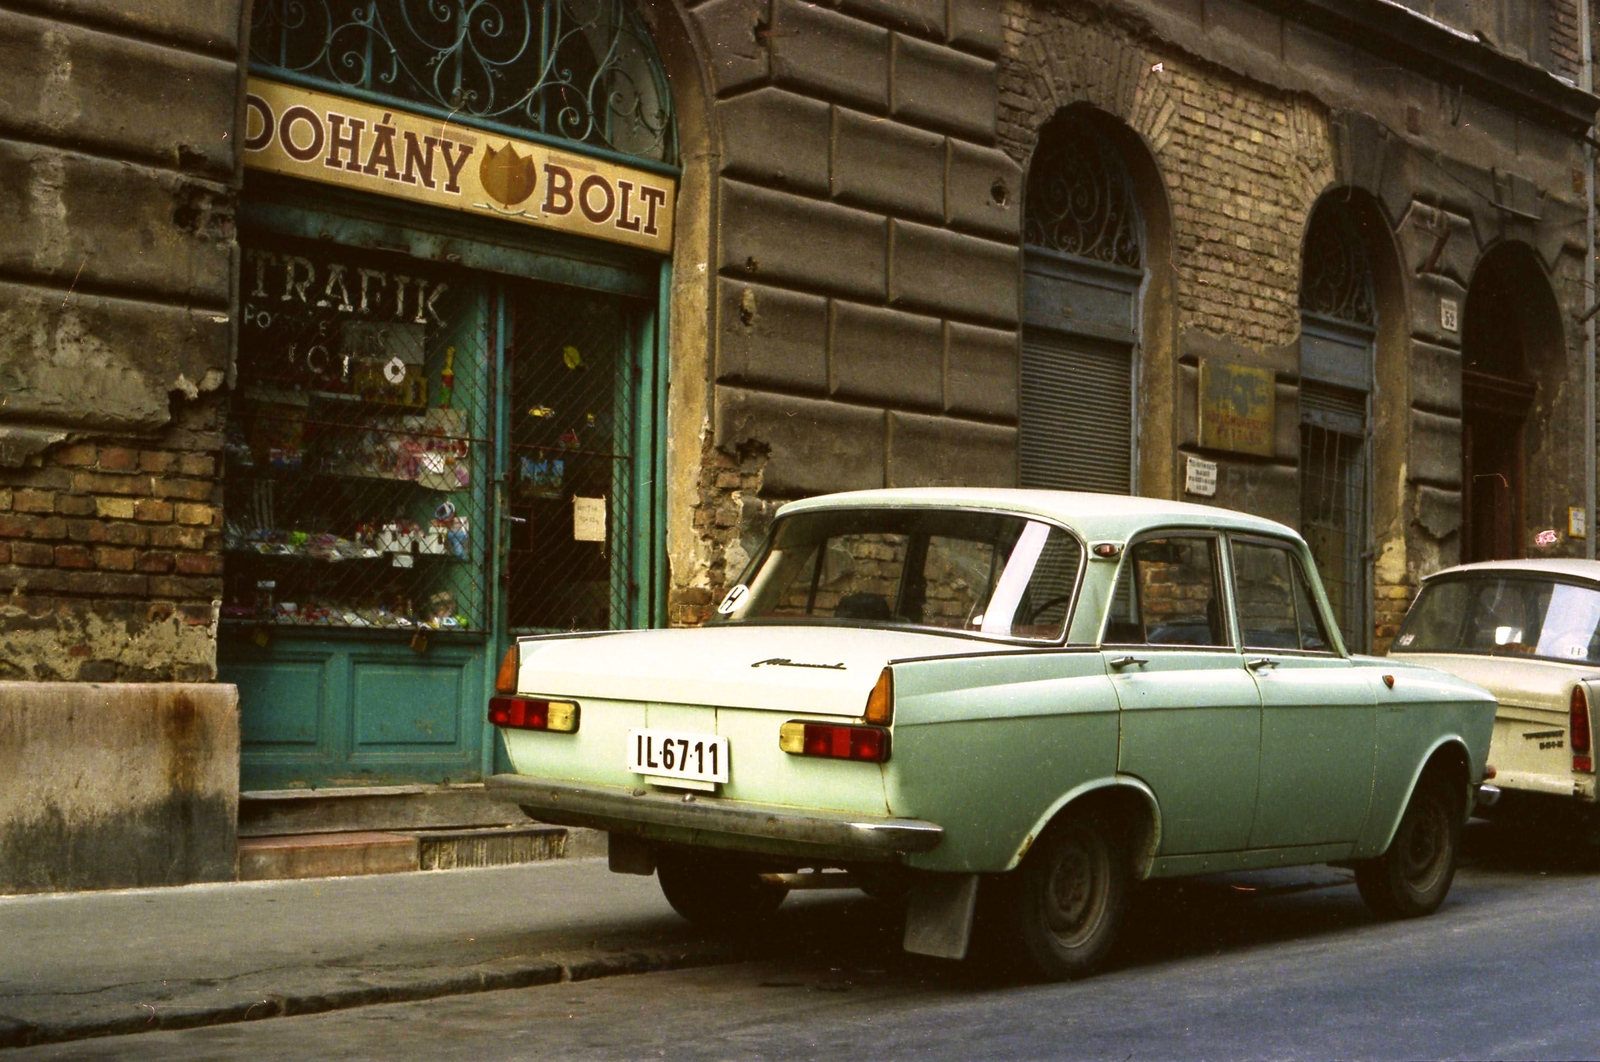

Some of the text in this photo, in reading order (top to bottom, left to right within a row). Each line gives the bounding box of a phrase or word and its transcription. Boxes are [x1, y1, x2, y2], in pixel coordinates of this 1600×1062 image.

[245, 92, 668, 237] DOHÁNY BOLT
[246, 249, 449, 328] TRAFIK
[720, 587, 745, 611] H
